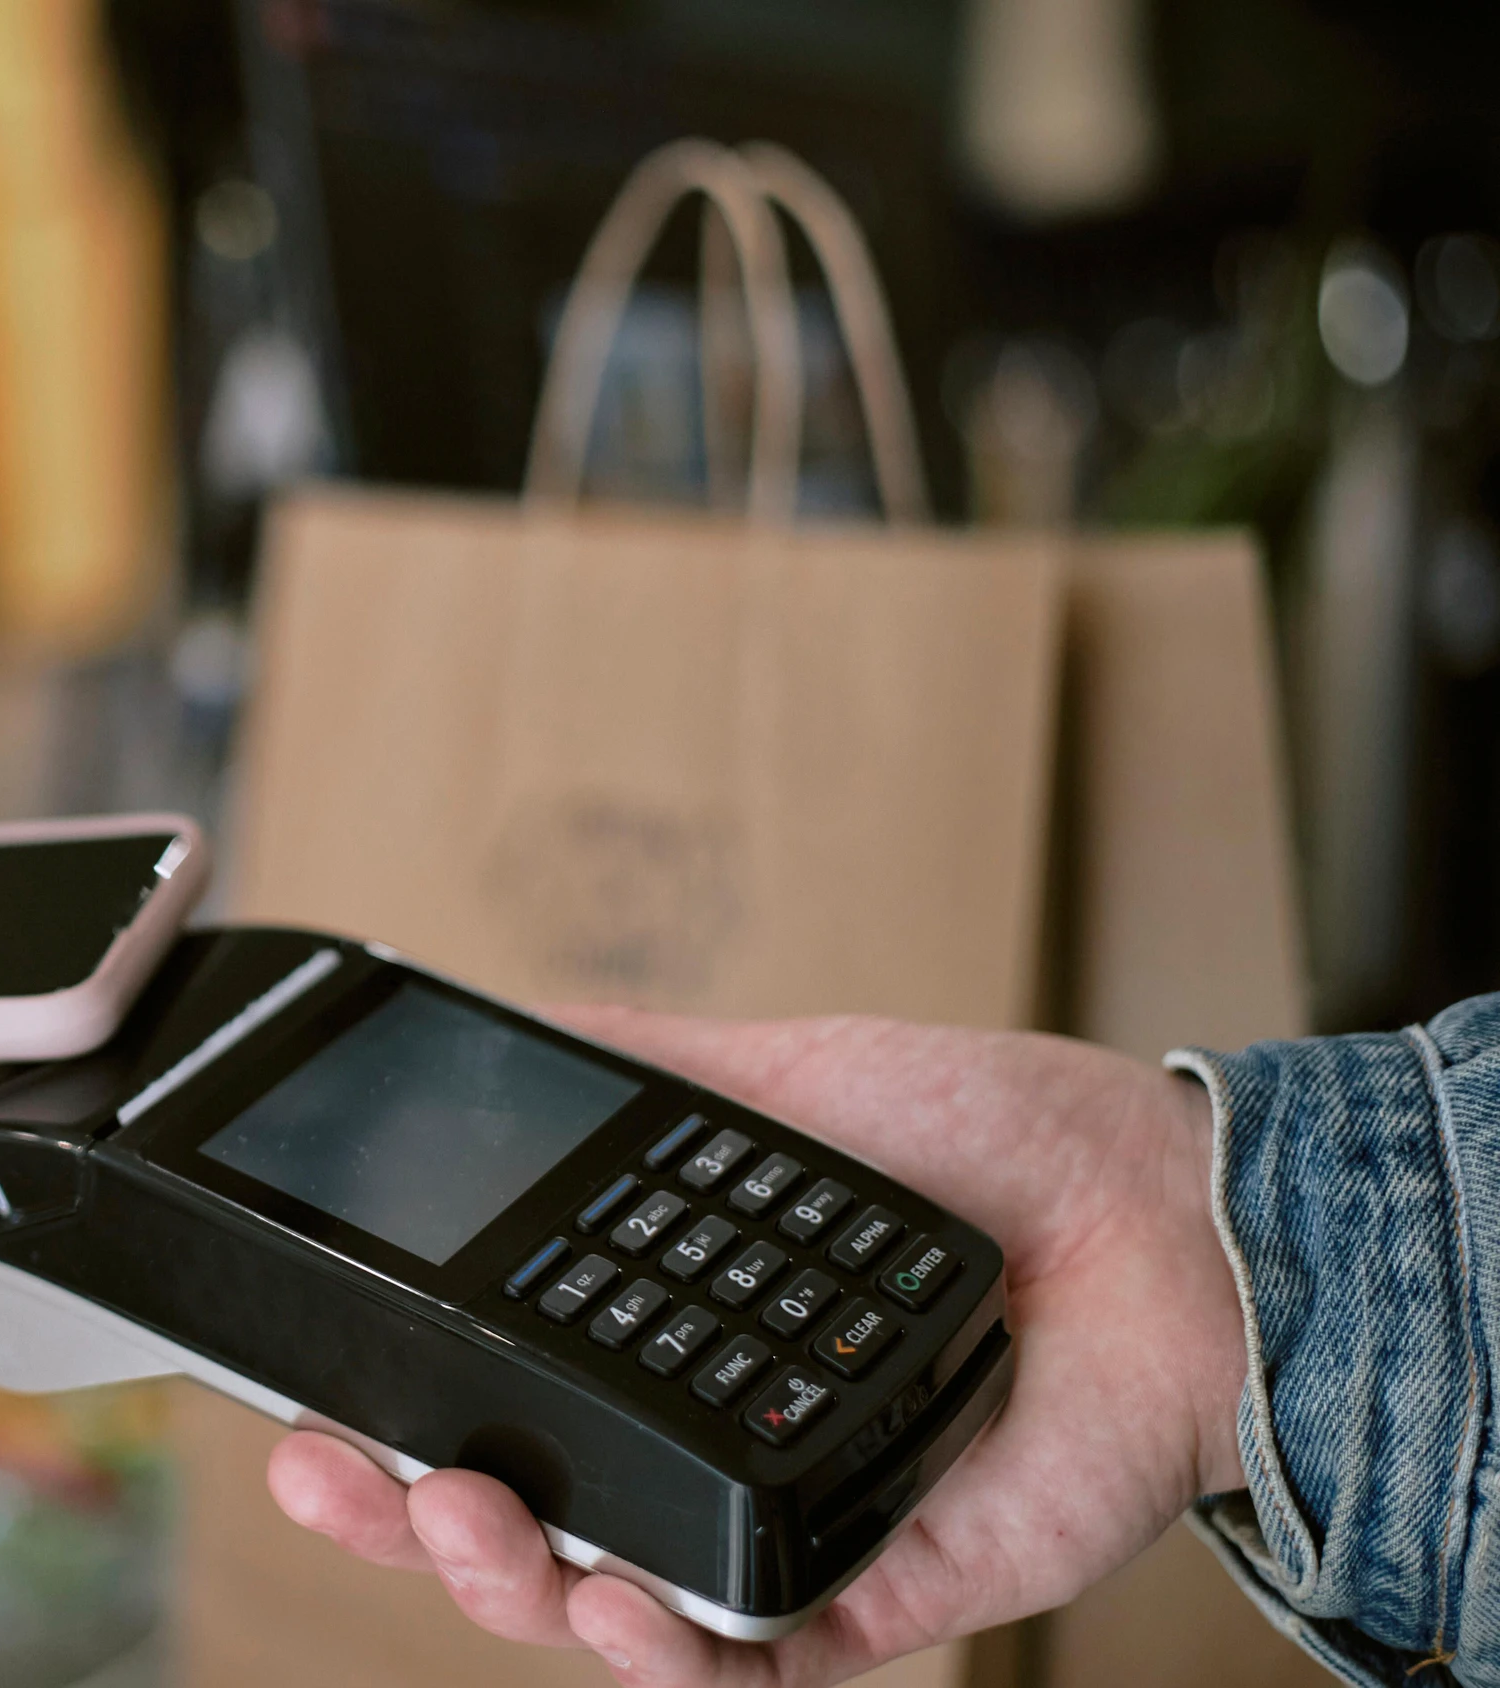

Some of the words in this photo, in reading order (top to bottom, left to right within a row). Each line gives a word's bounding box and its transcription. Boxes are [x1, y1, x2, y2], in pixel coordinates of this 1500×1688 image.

[695, 1156, 722, 1175] 3
[745, 1180, 773, 1198] 6
[761, 1165, 785, 1184] mno
[627, 1217, 657, 1237] 2
[647, 1204, 669, 1222] abc
[795, 1205, 823, 1224] 9
[676, 1241, 705, 1262] 5
[695, 1233, 713, 1249] jkl
[851, 1219, 889, 1254] ALPHA
[728, 1268, 756, 1288] 8
[745, 1258, 765, 1275] tuv
[910, 1247, 946, 1279] ENTER
[557, 1283, 586, 1298] 1
[610, 1306, 637, 1326] 4
[626, 1295, 645, 1314] ghi
[779, 1298, 807, 1317] 0
[656, 1333, 686, 1354] 7
[674, 1321, 694, 1340] prs
[845, 1311, 883, 1344] CLEAR
[715, 1352, 752, 1385] FUNC
[782, 1383, 827, 1422] CANCEL
